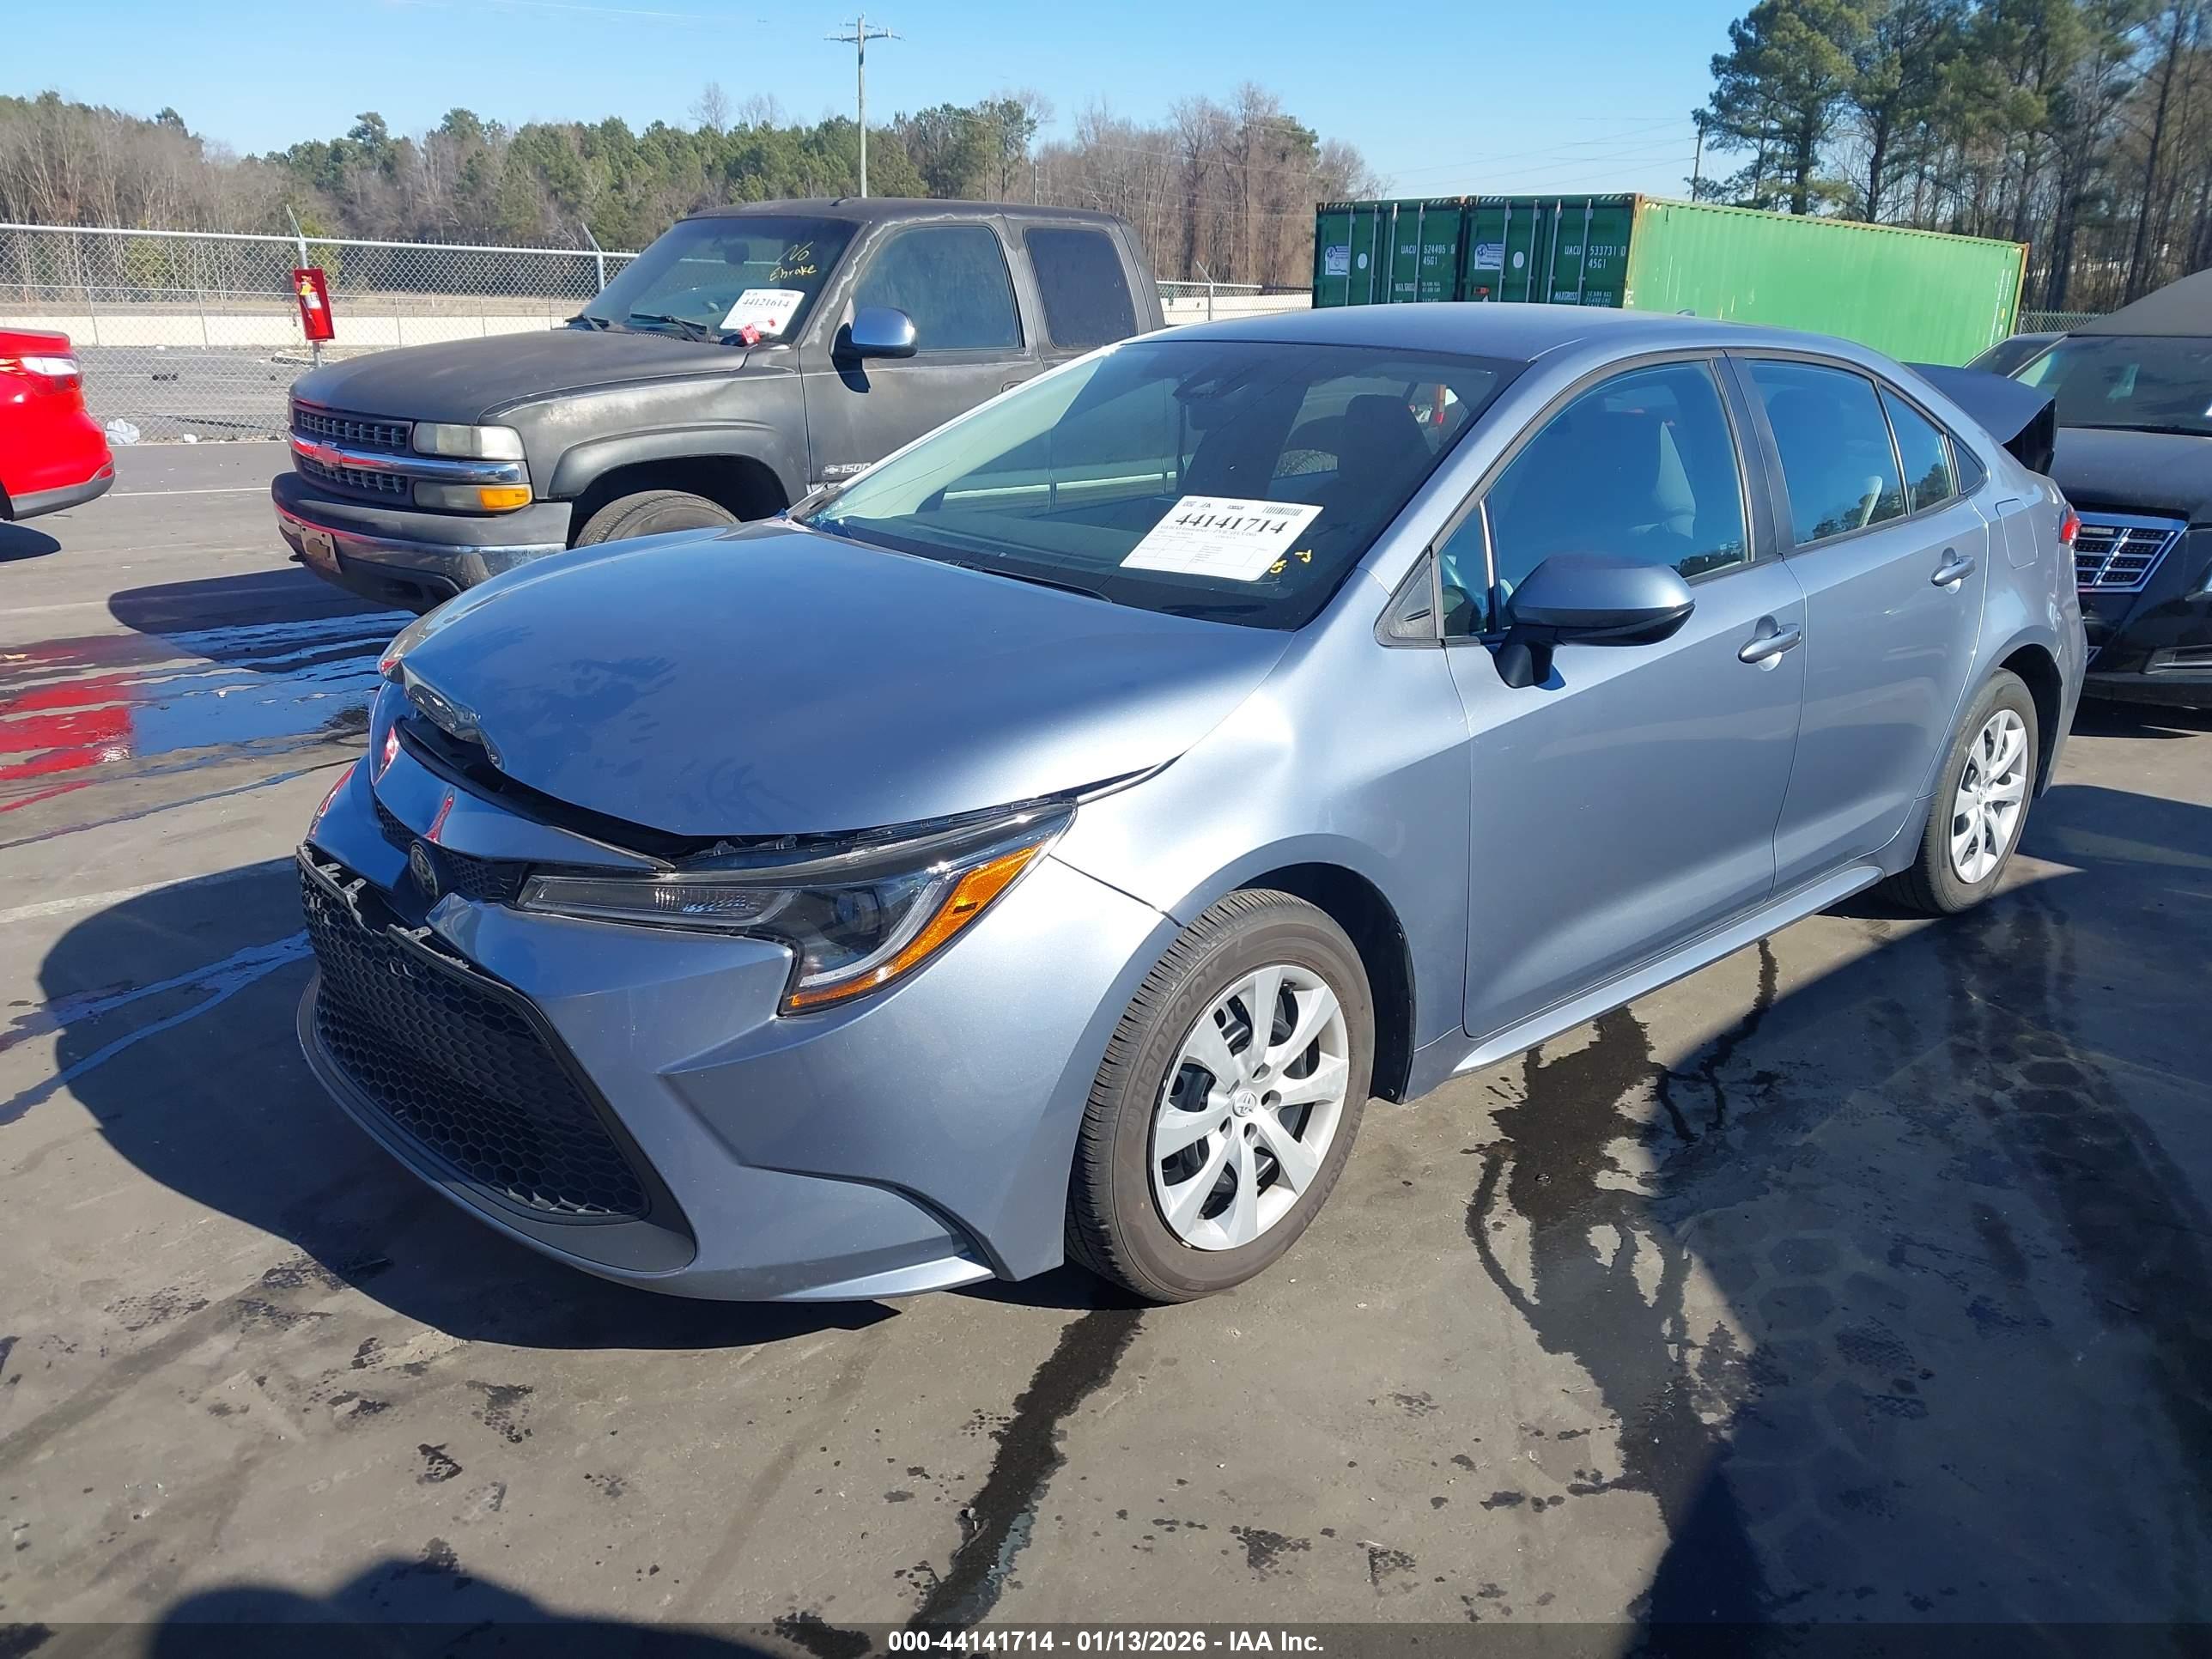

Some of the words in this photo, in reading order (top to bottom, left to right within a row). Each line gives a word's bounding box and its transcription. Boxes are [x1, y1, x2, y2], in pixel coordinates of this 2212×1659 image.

[1565, 245, 1582, 255] UACU
[1589, 246, 1616, 256] 533731
[1588, 258, 1607, 269] 45G1
[1175, 514, 1288, 534] 44141714
